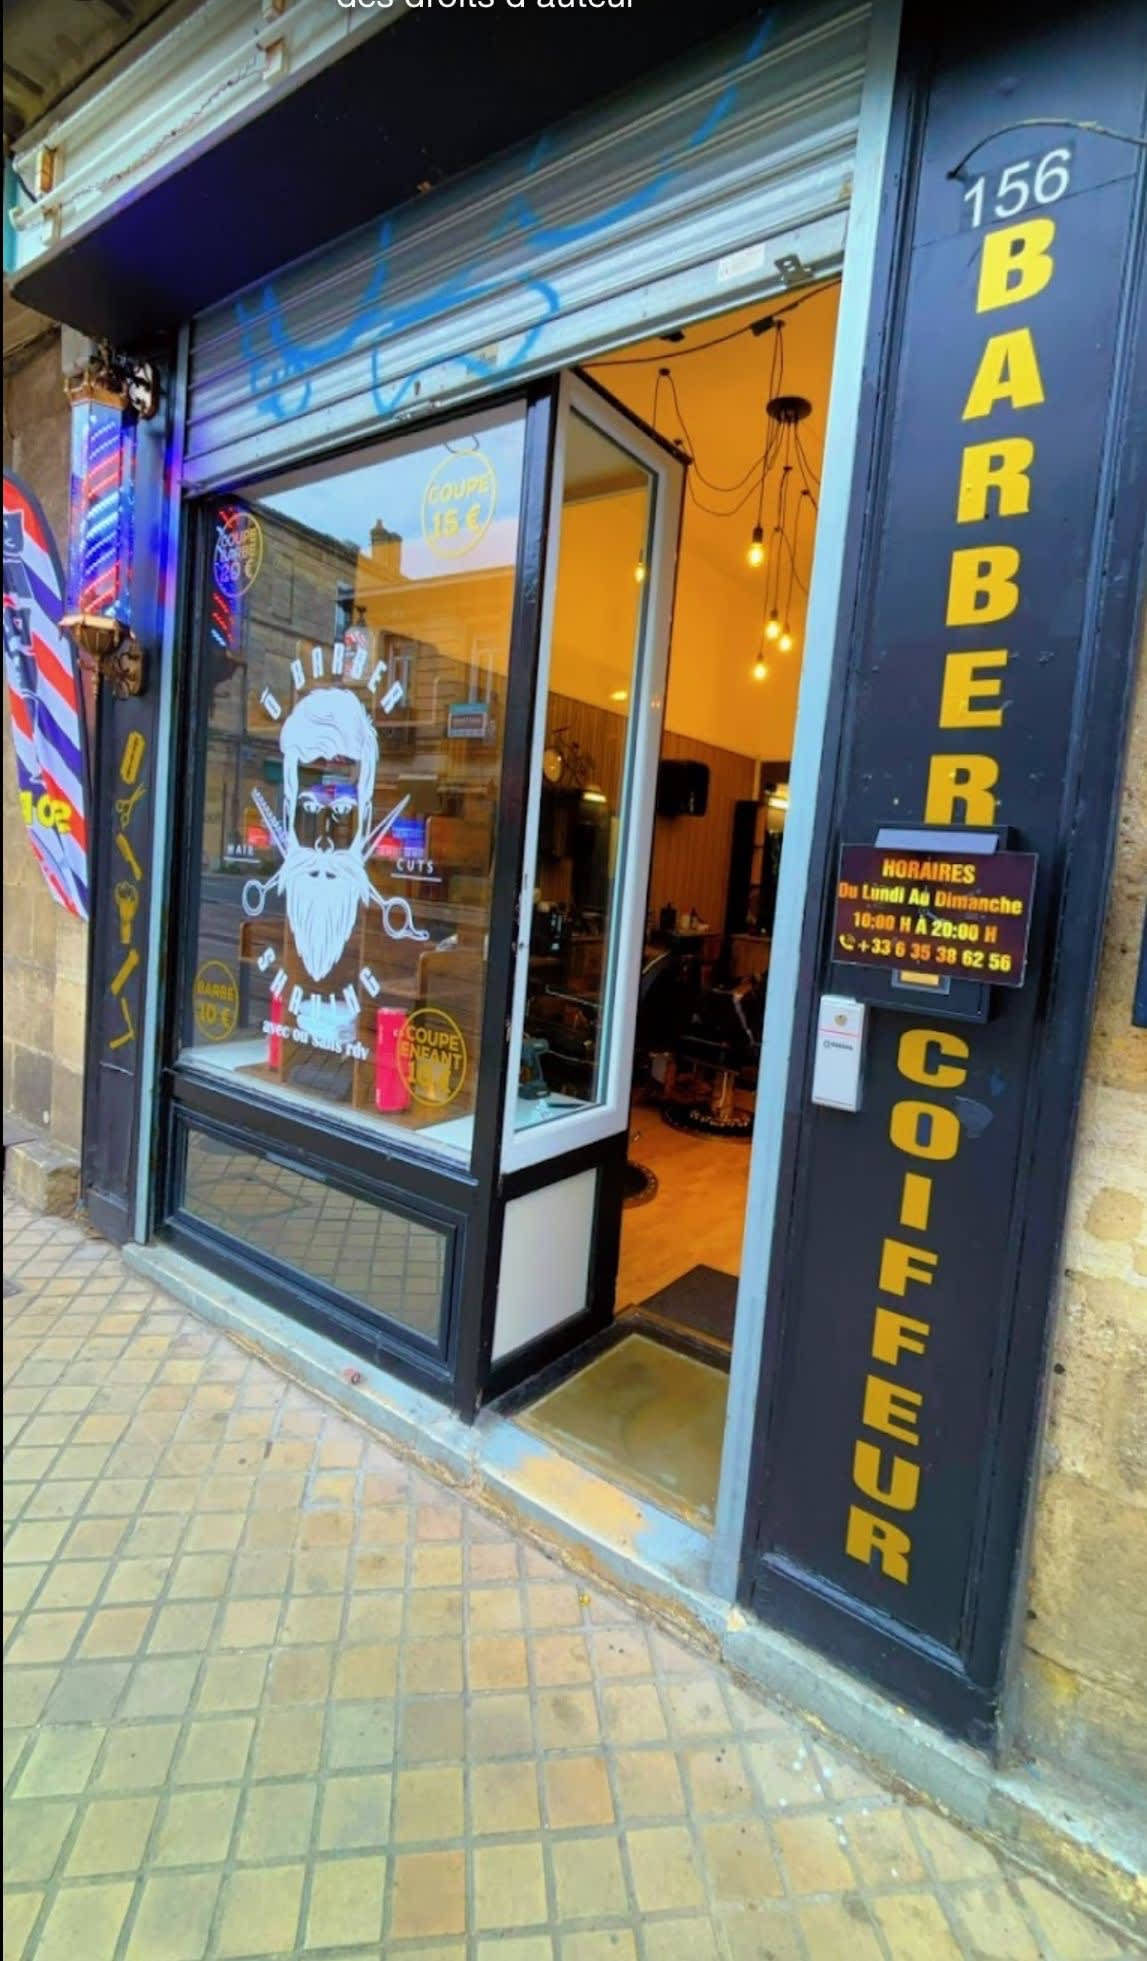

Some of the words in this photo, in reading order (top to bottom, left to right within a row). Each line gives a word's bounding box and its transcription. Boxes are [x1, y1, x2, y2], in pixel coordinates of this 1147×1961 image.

[964, 148, 1071, 229] 156
[428, 474, 490, 505] COUPE
[432, 508, 460, 538] 15
[465, 502, 482, 535] €
[923, 218, 1056, 826] BARBER
[290, 642, 404, 715] BARBER
[226, 843, 255, 856] HAIR
[396, 858, 434, 874] CUTS
[882, 857, 976, 885] HORAIRES
[838, 881, 859, 899] Du
[862, 883, 905, 905] Lundi
[908, 886, 931, 907] Au
[934, 889, 1024, 916] Dimanche
[853, 911, 896, 931] 10:00
[899, 915, 911, 932] H
[931, 919, 980, 942] 20:00
[983, 924, 999, 944] H
[857, 937, 892, 956] +33
[894, 940, 906, 958] 6
[910, 942, 931, 961] 35
[935, 946, 957, 965] 38
[961, 949, 984, 969] 62
[988, 952, 1012, 973] 56
[195, 979, 236, 1002] BARBE
[257, 946, 381, 1019] SHAVING
[199, 1003, 217, 1025] 10
[262, 1019, 290, 1039] avec
[292, 1028, 309, 1044] ou
[311, 1032, 343, 1054] sans
[345, 1041, 371, 1061] rdv
[399, 1040, 462, 1071] ENFANT
[405, 1024, 461, 1052] COUPE
[845, 1028, 970, 1585] COIFFEUR
